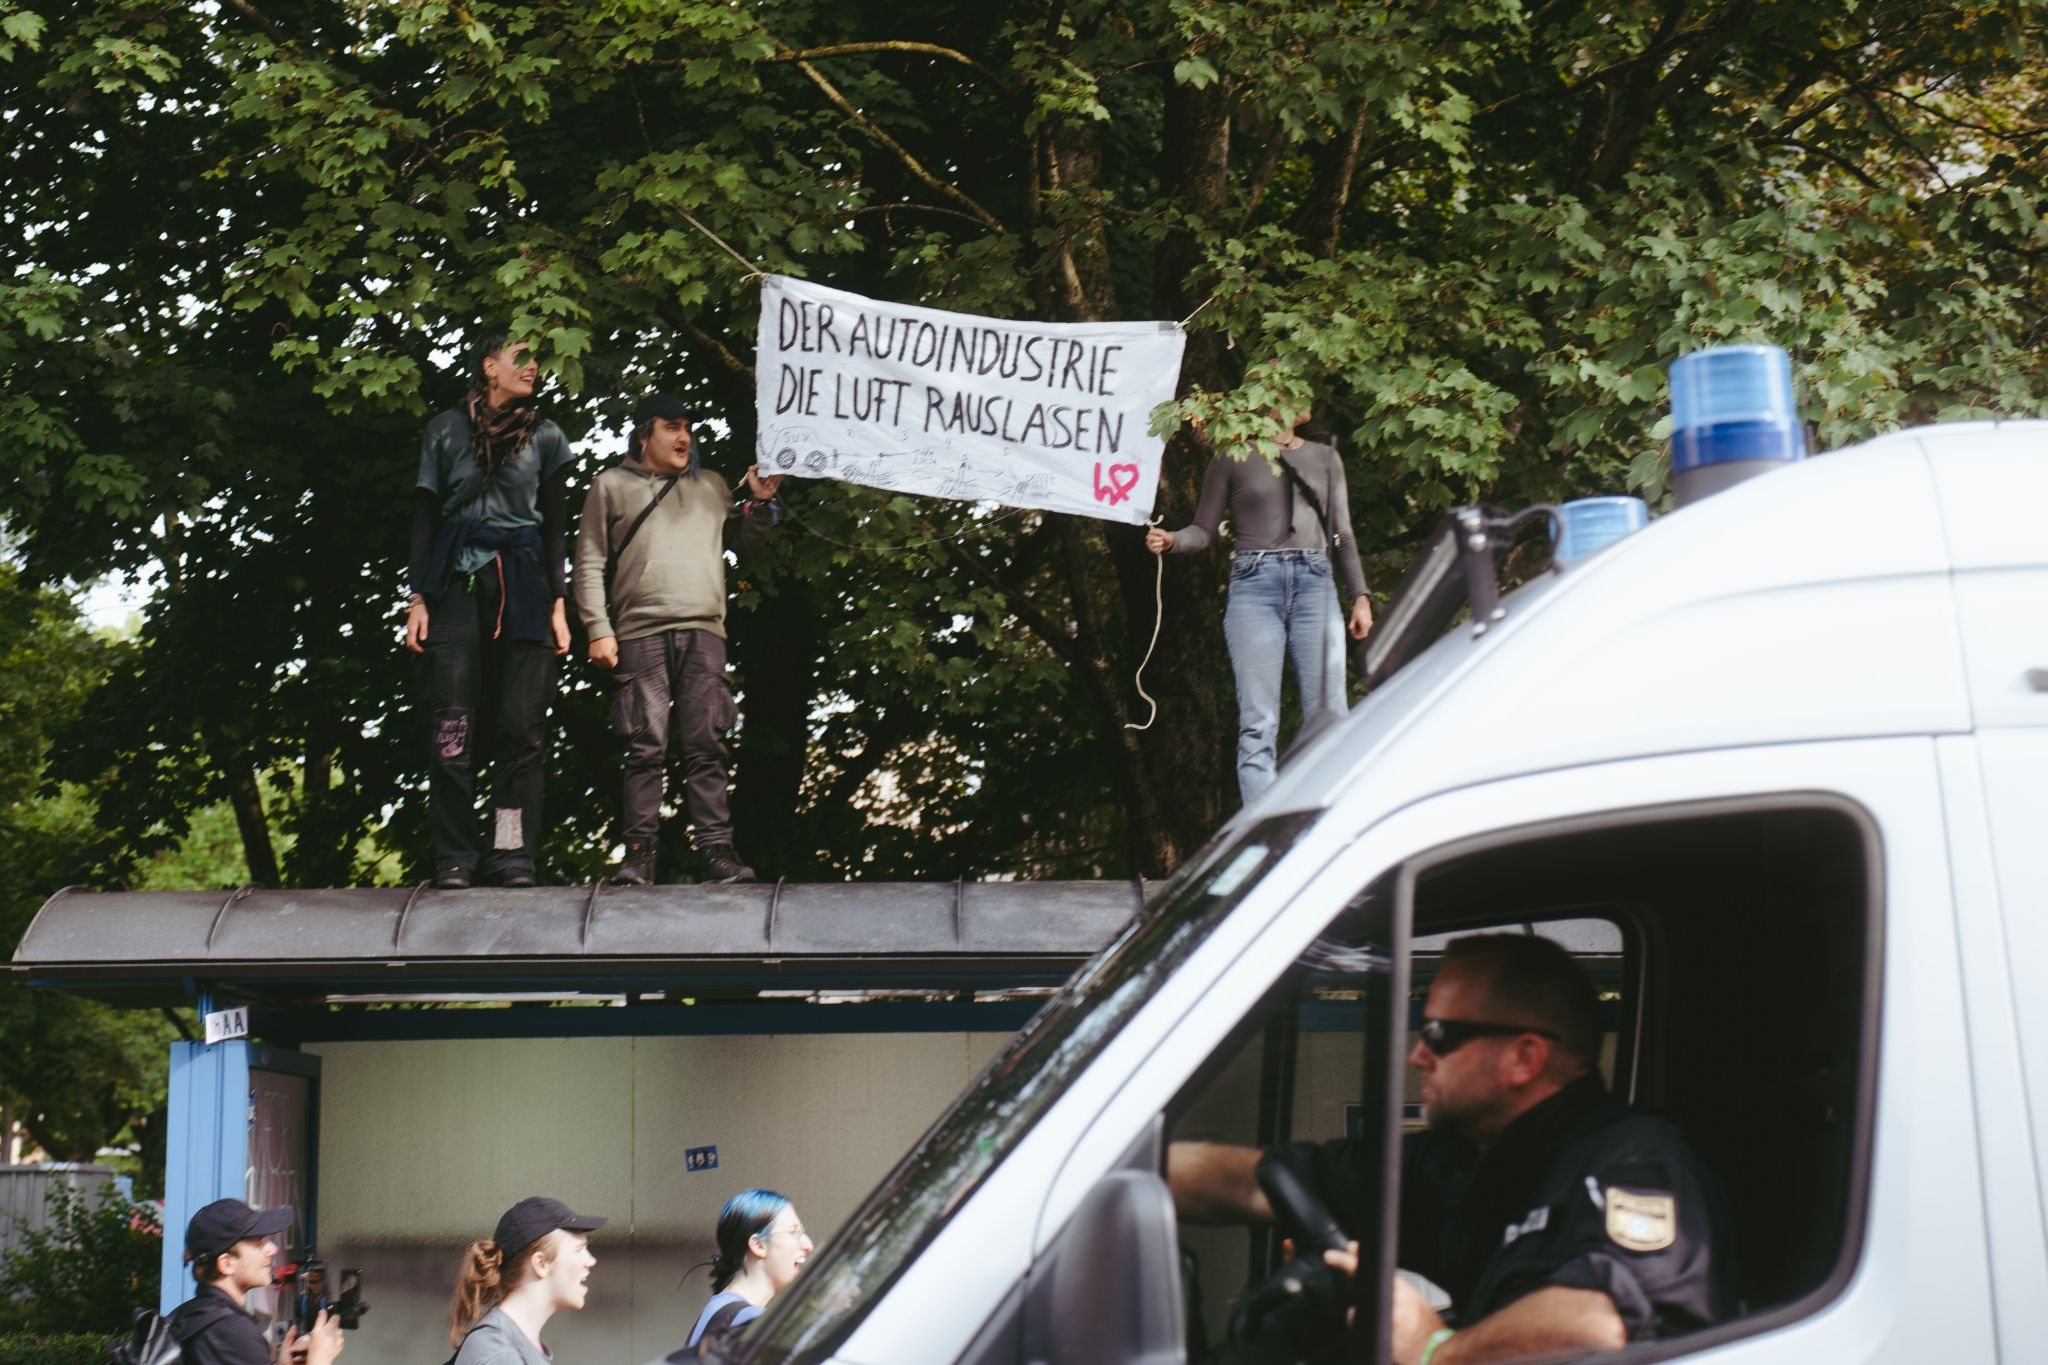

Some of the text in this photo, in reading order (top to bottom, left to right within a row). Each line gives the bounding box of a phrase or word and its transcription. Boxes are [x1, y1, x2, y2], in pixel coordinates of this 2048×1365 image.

[779, 297, 1123, 397] DER AUTOINDUSTRIE
[776, 363, 823, 416] DIE
[835, 373, 911, 427] LUFT
